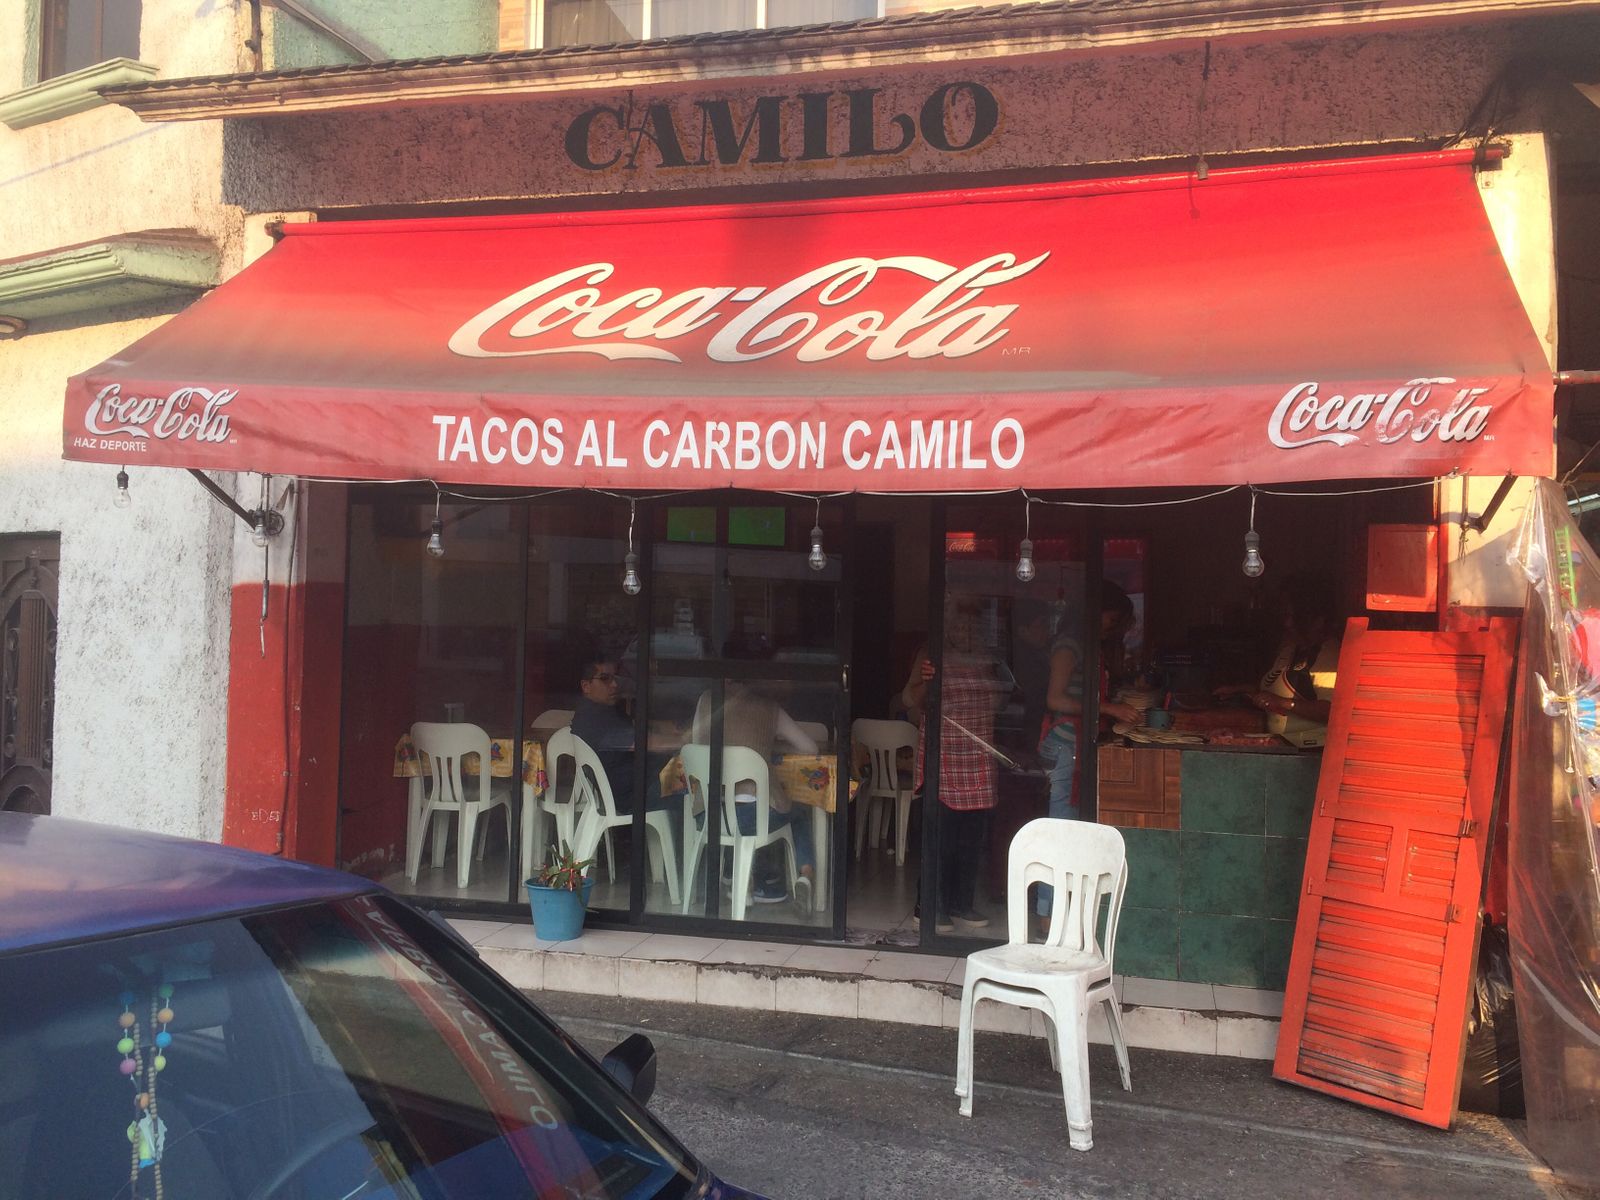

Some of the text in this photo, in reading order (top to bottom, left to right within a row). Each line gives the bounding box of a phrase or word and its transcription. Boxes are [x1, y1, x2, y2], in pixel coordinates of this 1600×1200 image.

[563, 80, 999, 171] CAMILO
[447, 250, 1051, 363] Coca-Cola
[73, 437, 147, 452] HAZ DEPORTE
[84, 383, 239, 444] Coca-Cola
[432, 415, 1025, 470] TACOS AL CARBON CAMILO
[1267, 377, 1494, 449] Coca-Cola
